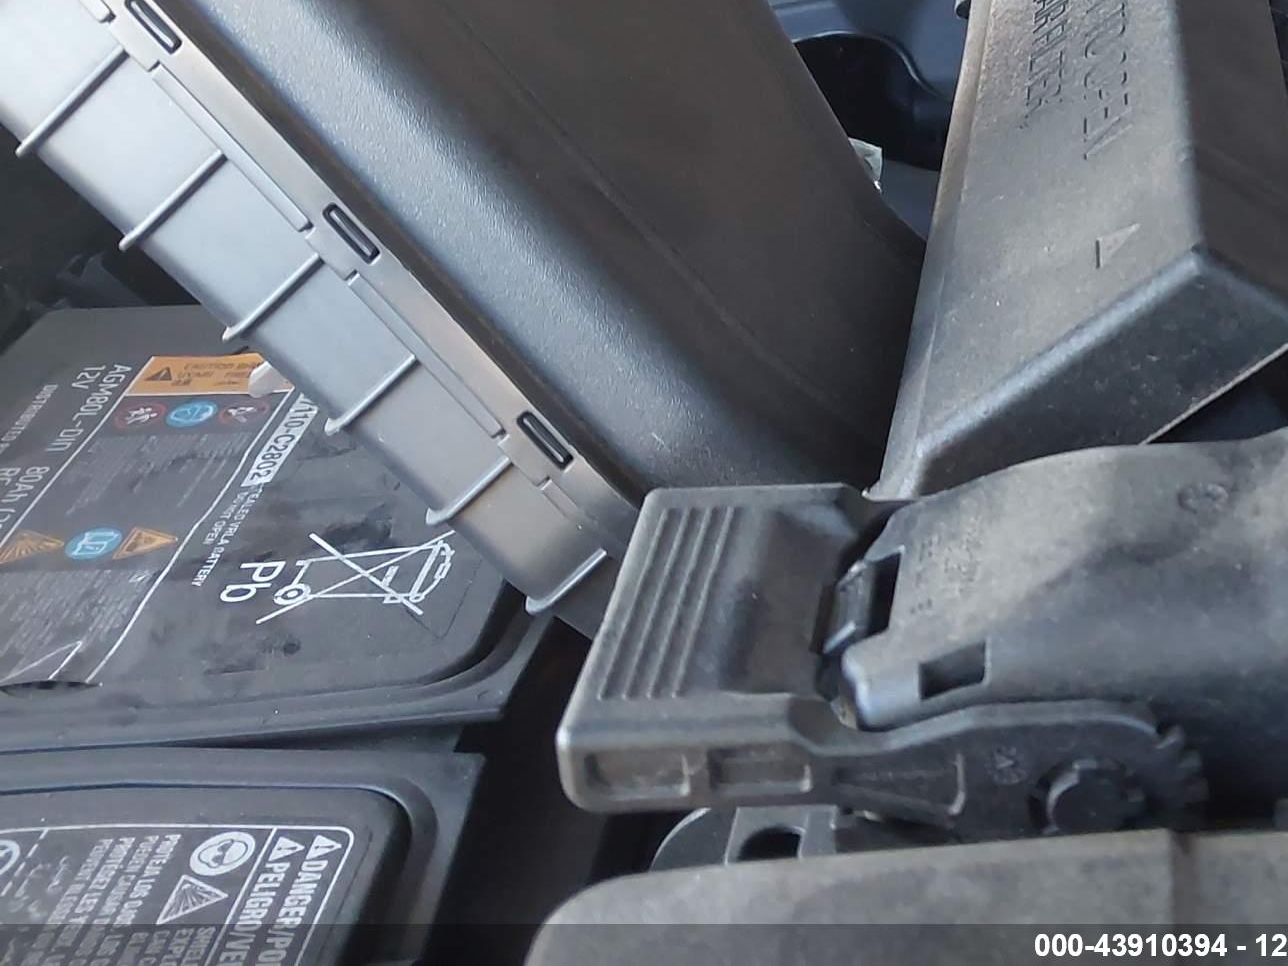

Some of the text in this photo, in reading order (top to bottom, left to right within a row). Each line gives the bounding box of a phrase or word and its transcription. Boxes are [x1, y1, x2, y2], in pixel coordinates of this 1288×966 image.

[71, 365, 106, 390] 12V
[1, 466, 50, 503] 80Ah
[203, 520, 226, 545] OPEN
[217, 520, 242, 546] VRLA
[191, 544, 225, 587] BATTERY
[220, 561, 286, 602] Pb
[124, 835, 159, 873] PUEDEN
[141, 834, 181, 878] PROTEJA
[74, 892, 102, 914] LES
[98, 874, 136, 916] CAUSAR
[129, 878, 156, 899] LOS
